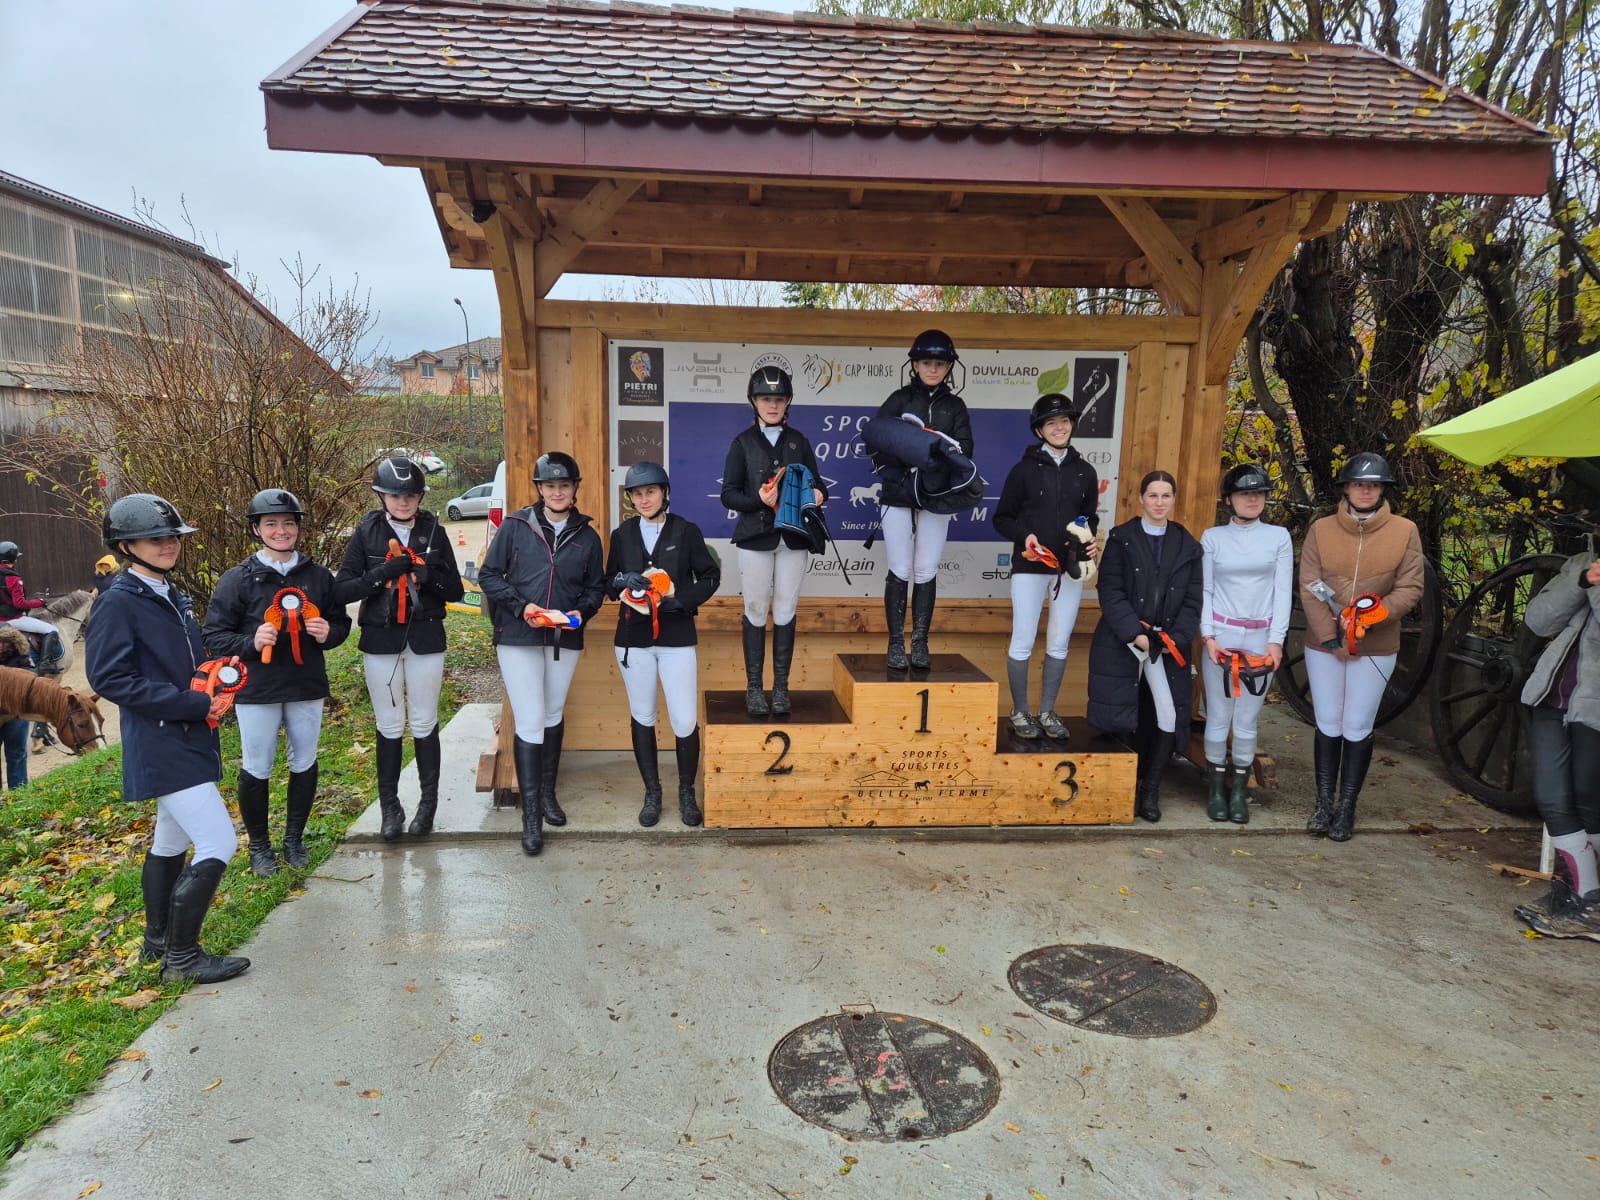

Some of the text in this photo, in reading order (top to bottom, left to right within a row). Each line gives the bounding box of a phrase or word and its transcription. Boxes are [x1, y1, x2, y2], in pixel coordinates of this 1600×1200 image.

[972, 366, 1039, 376] DUVILLARD
[624, 382, 658, 391] PIETRI
[822, 415, 871, 432] SPO
[814, 442, 866, 462] QUE
[840, 520, 866, 530] Since
[807, 557, 874, 573] Jean Lain
[914, 688, 932, 734] 1
[764, 730, 794, 777] 2
[902, 750, 948, 758] SPORTS
[891, 762, 960, 771] EQUESTRES
[1052, 760, 1080, 807] 3
[857, 788, 990, 798] BELLE FERME
